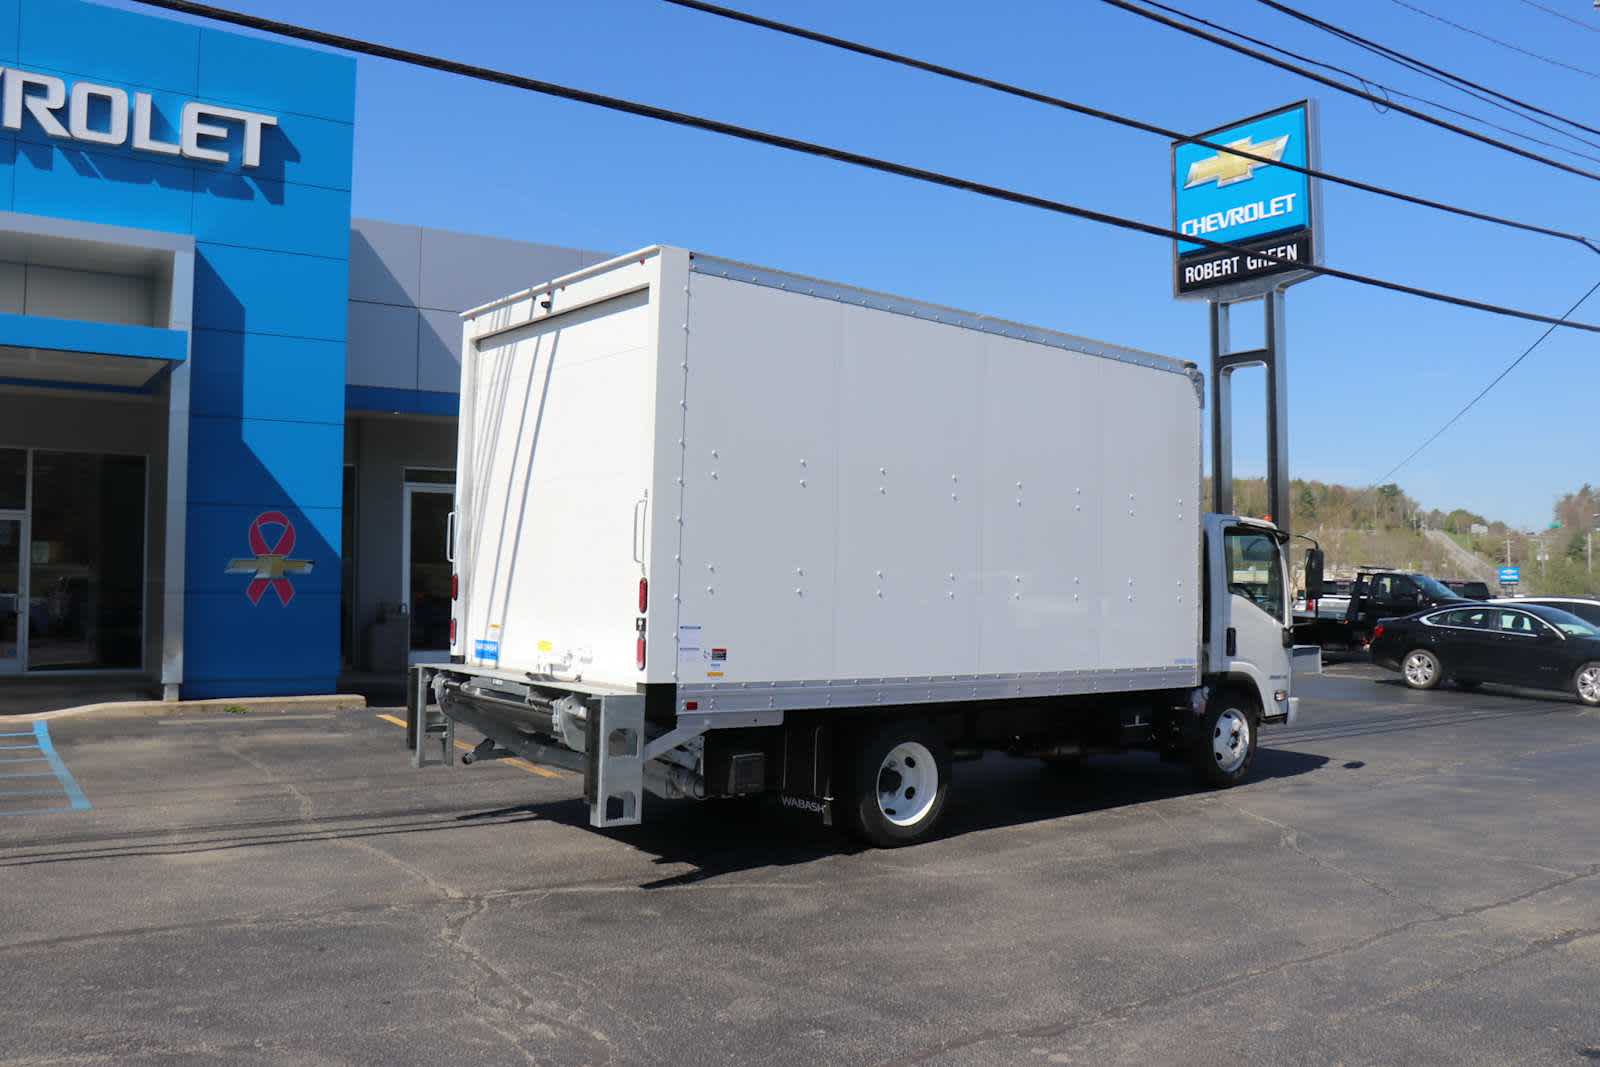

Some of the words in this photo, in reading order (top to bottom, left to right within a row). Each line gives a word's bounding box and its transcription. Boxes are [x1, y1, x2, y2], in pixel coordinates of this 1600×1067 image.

[0, 66, 278, 168] ROLET
[1181, 193, 1297, 237] CHEVROLET
[1184, 256, 1240, 284] ROBERT
[783, 796, 825, 814] WABASH
